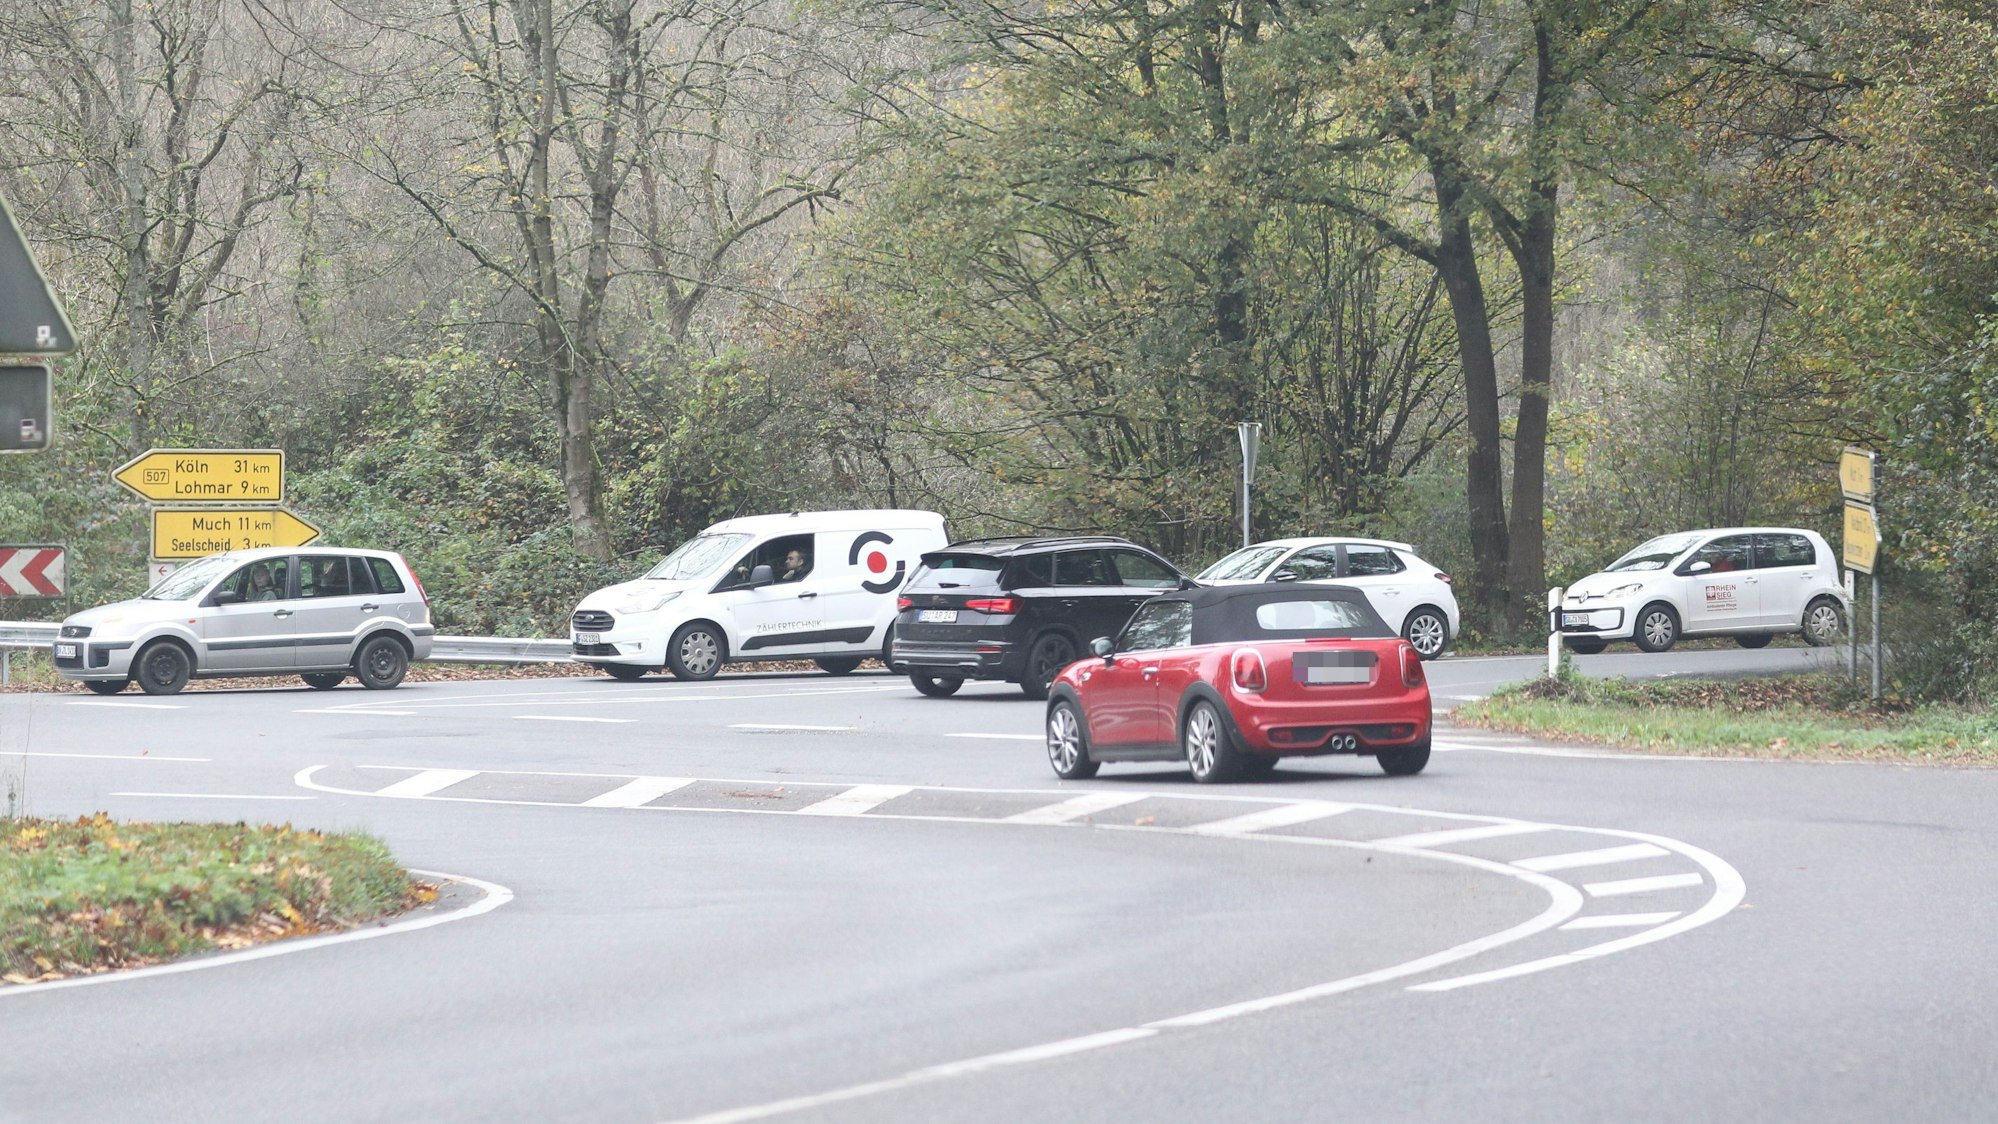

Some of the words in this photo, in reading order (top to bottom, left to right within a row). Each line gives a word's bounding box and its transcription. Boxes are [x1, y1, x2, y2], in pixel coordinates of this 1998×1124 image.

[175, 459, 209, 473] Köln
[234, 460, 248, 473] 31
[253, 463, 270, 473] km
[146, 471, 166, 482] 507
[175, 481, 233, 494] Lohmar
[241, 481, 249, 494] 9
[252, 484, 270, 494] km
[192, 517, 231, 531] Much
[238, 517, 250, 530] 11
[254, 520, 272, 530] km
[171, 538, 231, 552] Seelscheid
[243, 538, 251, 551] 3
[254, 541, 272, 549] km
[1715, 584, 1737, 592] RHEIN
[1716, 591, 1732, 599] SIEG
[756, 619, 822, 634] ZÄHLERTECHNIK
